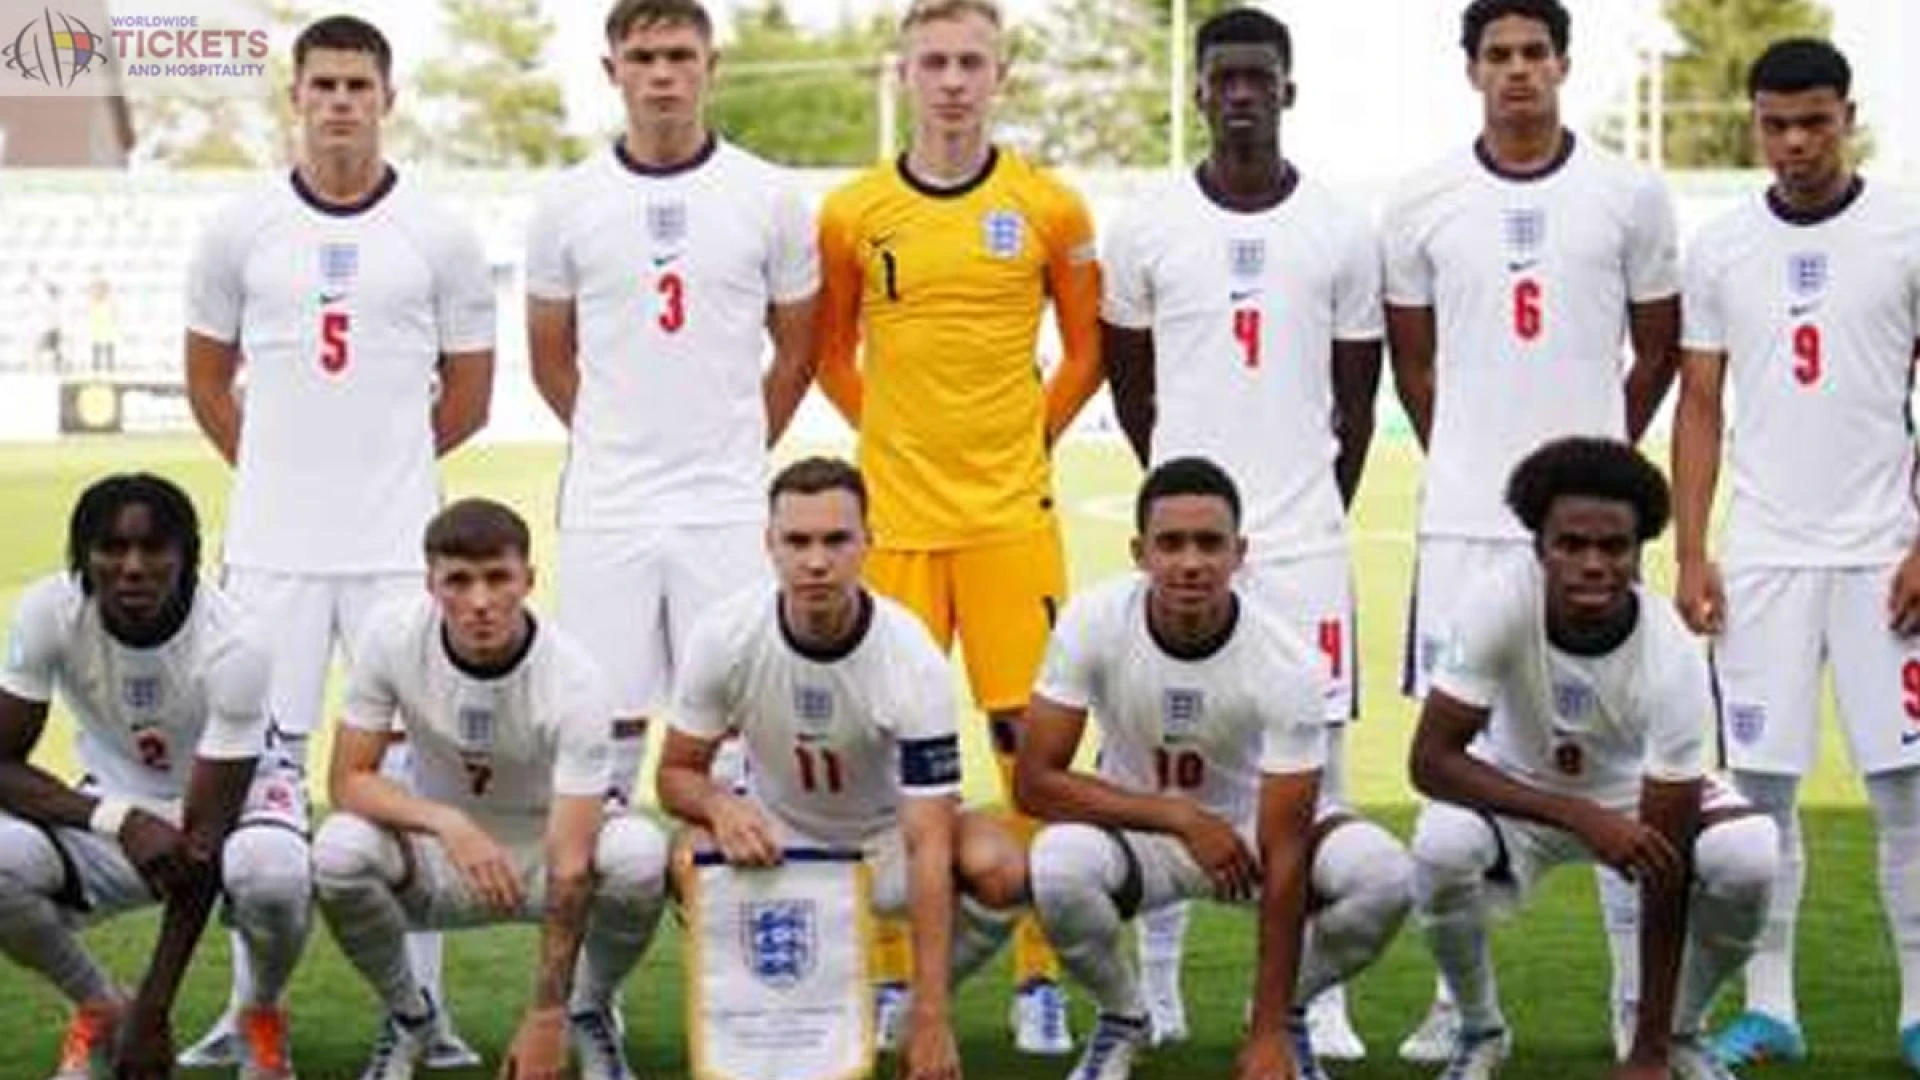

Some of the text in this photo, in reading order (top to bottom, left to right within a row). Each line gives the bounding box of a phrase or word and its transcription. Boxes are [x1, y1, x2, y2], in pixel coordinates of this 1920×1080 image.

[657, 273, 685, 333] 3
[880, 250, 898, 301] 1
[1233, 310, 1261, 367] 4
[1514, 281, 1541, 341] 6
[320, 312, 349, 373] 5
[1792, 324, 1821, 386] 9
[1318, 620, 1342, 679] 4
[136, 730, 170, 771] 2
[464, 752, 493, 797] 7
[794, 746, 844, 793] 11
[1154, 747, 1205, 789] 10
